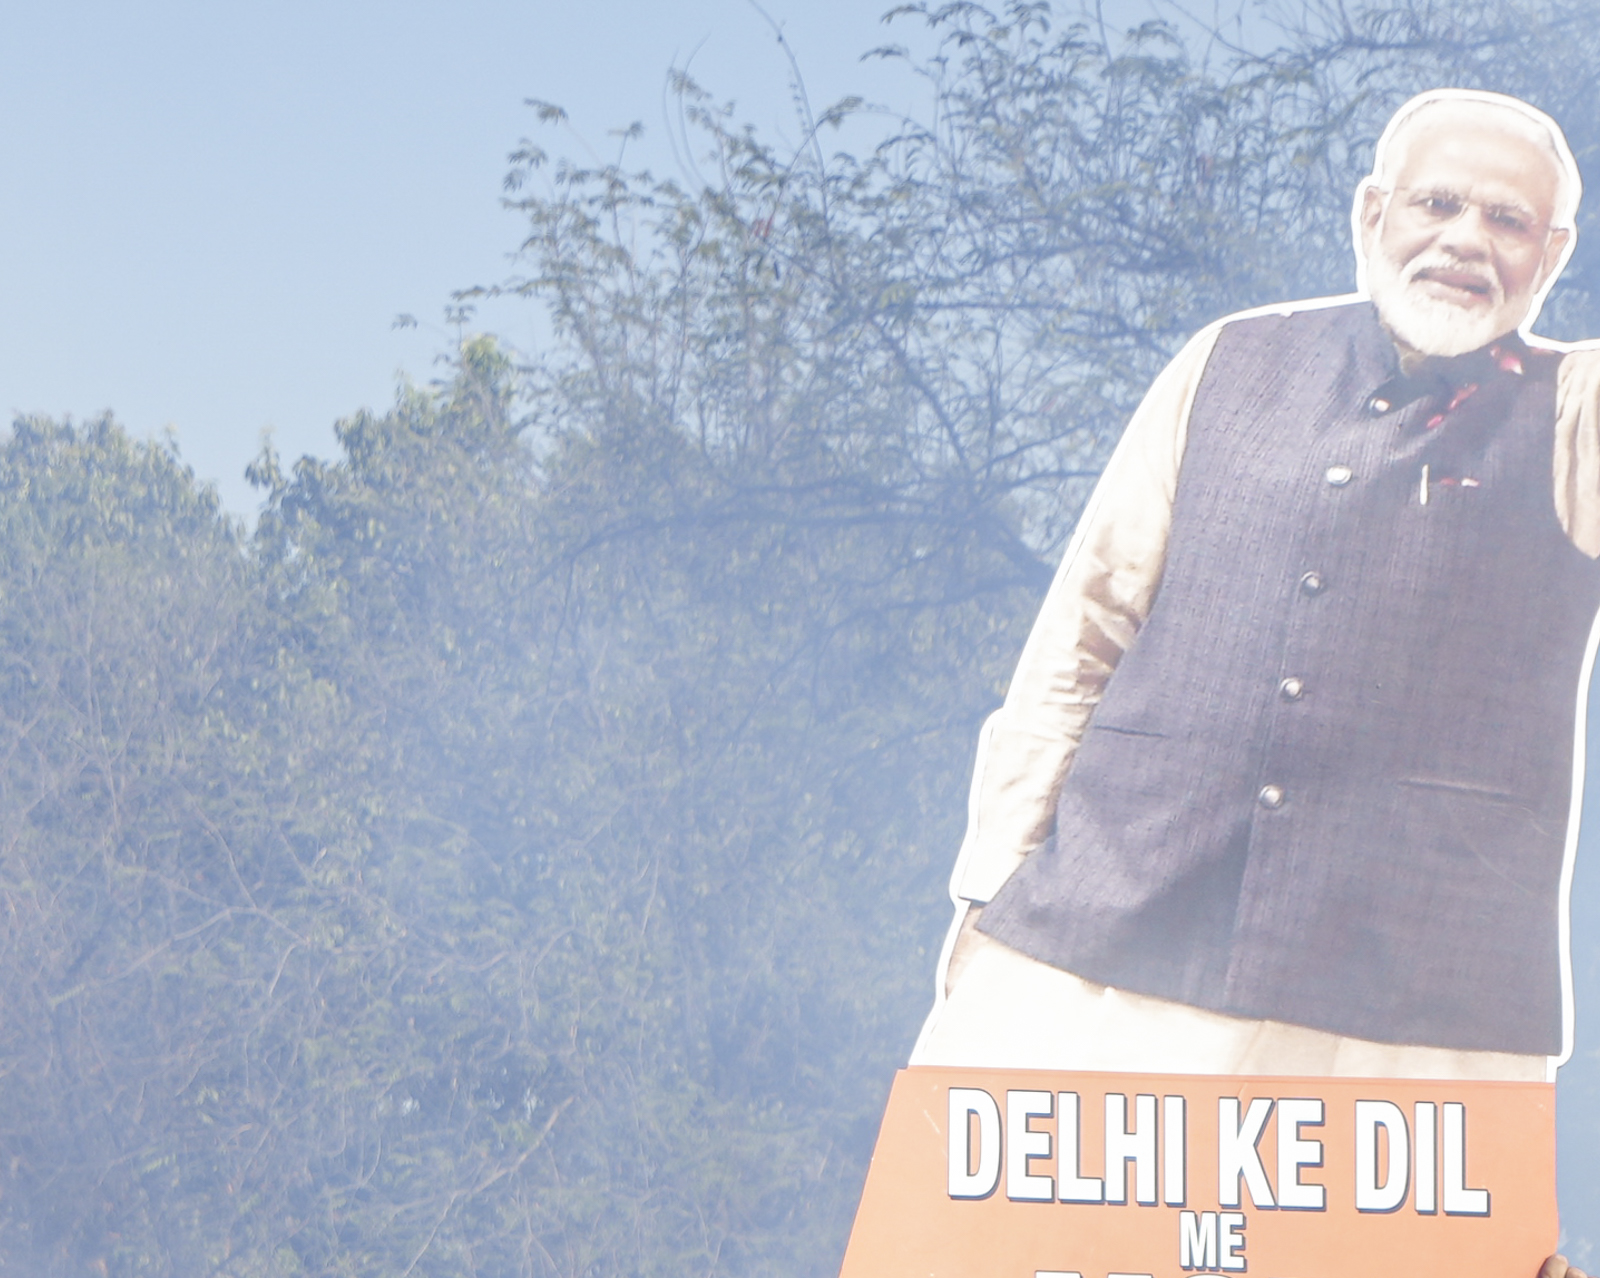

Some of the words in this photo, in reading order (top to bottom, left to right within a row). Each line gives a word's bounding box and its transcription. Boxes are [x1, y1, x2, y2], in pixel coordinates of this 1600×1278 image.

[947, 1087, 1187, 1207] DELHI
[1218, 1096, 1327, 1212] KE
[1354, 1099, 1492, 1217] DIL
[1179, 1210, 1248, 1273] ME
